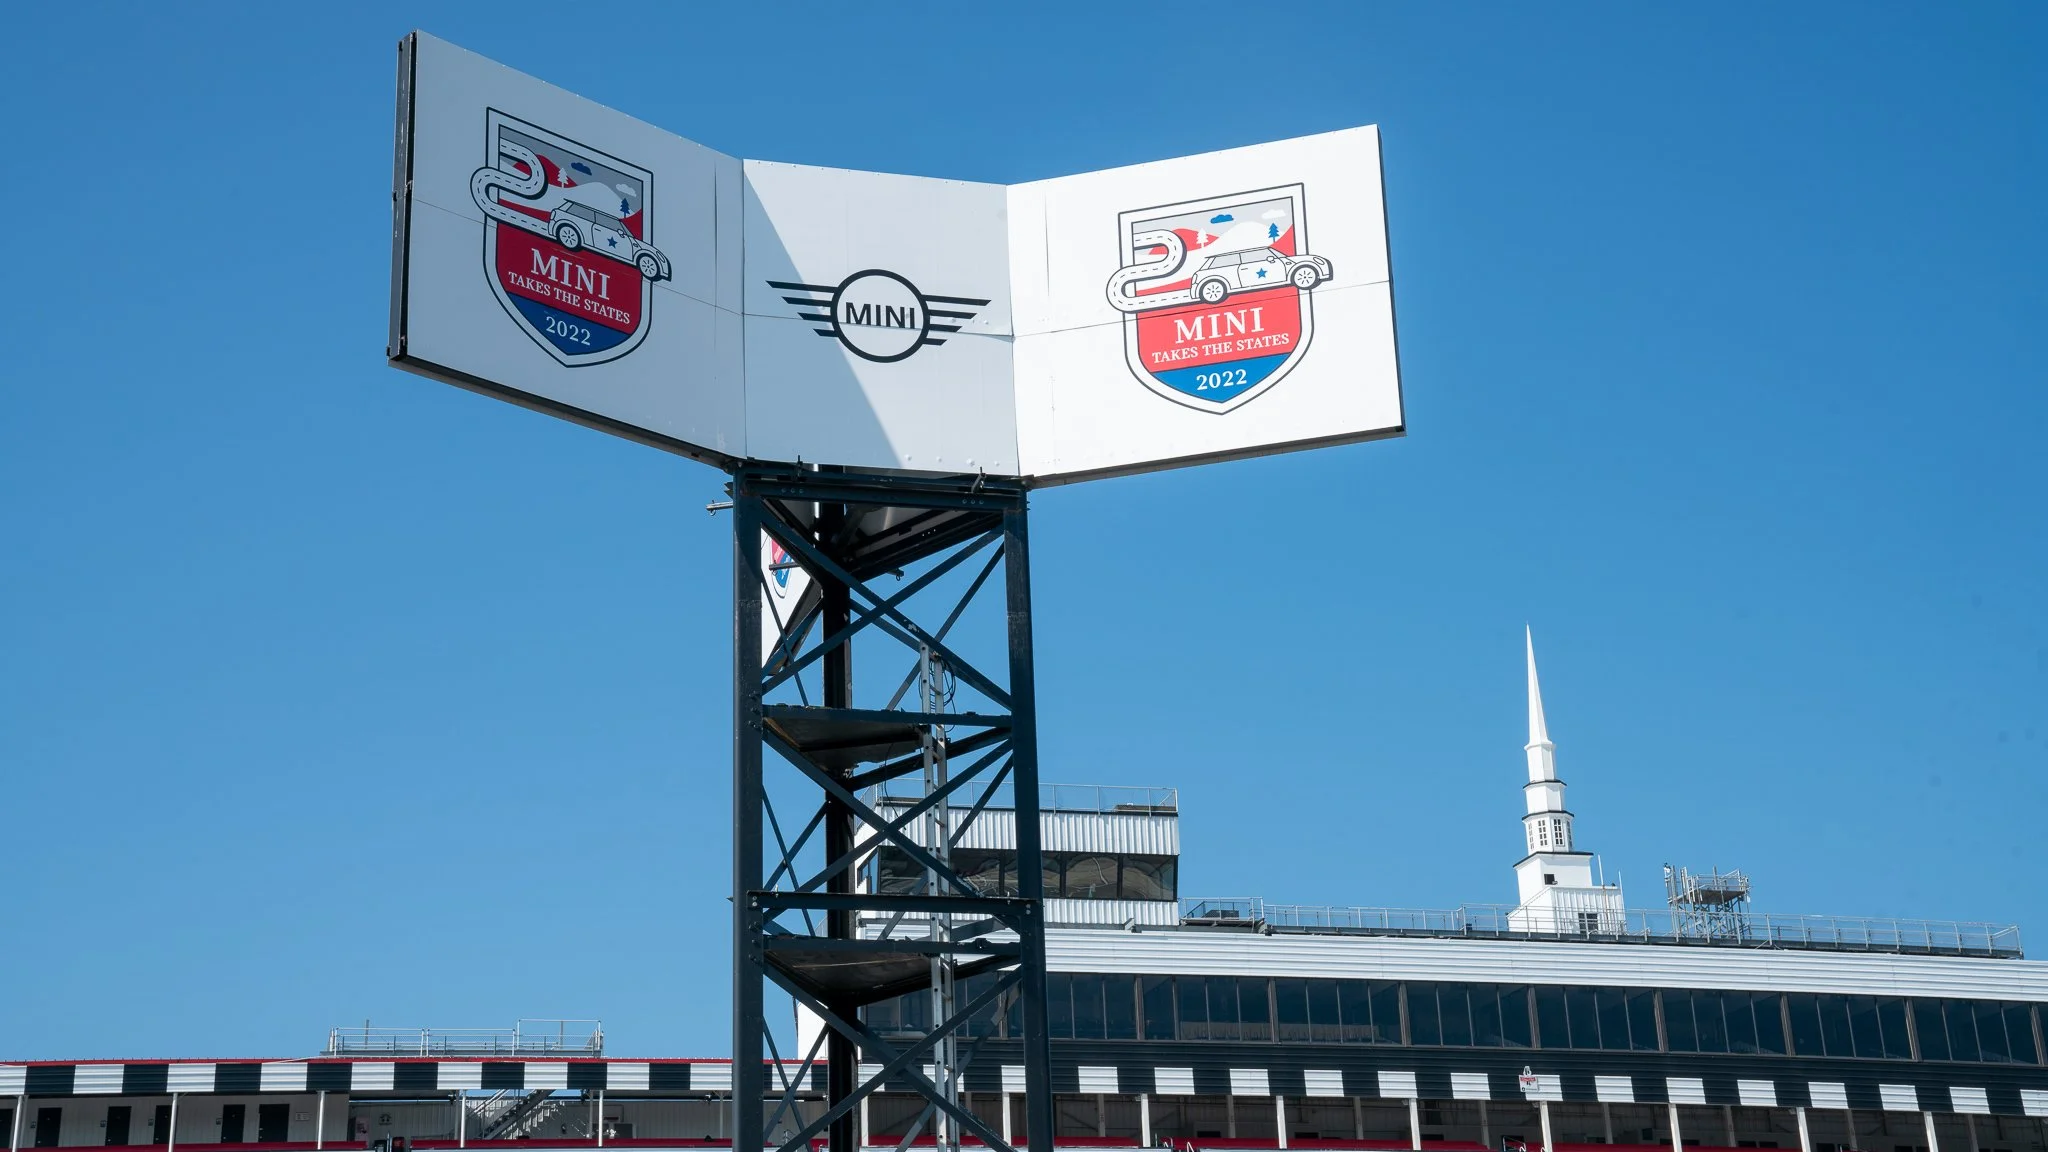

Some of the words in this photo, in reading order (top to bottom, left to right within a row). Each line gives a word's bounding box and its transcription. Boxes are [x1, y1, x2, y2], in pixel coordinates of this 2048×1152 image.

[531, 248, 610, 300] MINI
[508, 271, 550, 296] TAKES
[554, 287, 581, 308] THE
[584, 299, 631, 324] STATES
[546, 316, 591, 346] 2022
[846, 302, 915, 329] MINI
[1174, 307, 1265, 344] MINI
[1152, 347, 1199, 364] TAKES
[1202, 341, 1233, 356] THE
[1236, 333, 1290, 351] STATES
[1196, 368, 1247, 390] 2022
